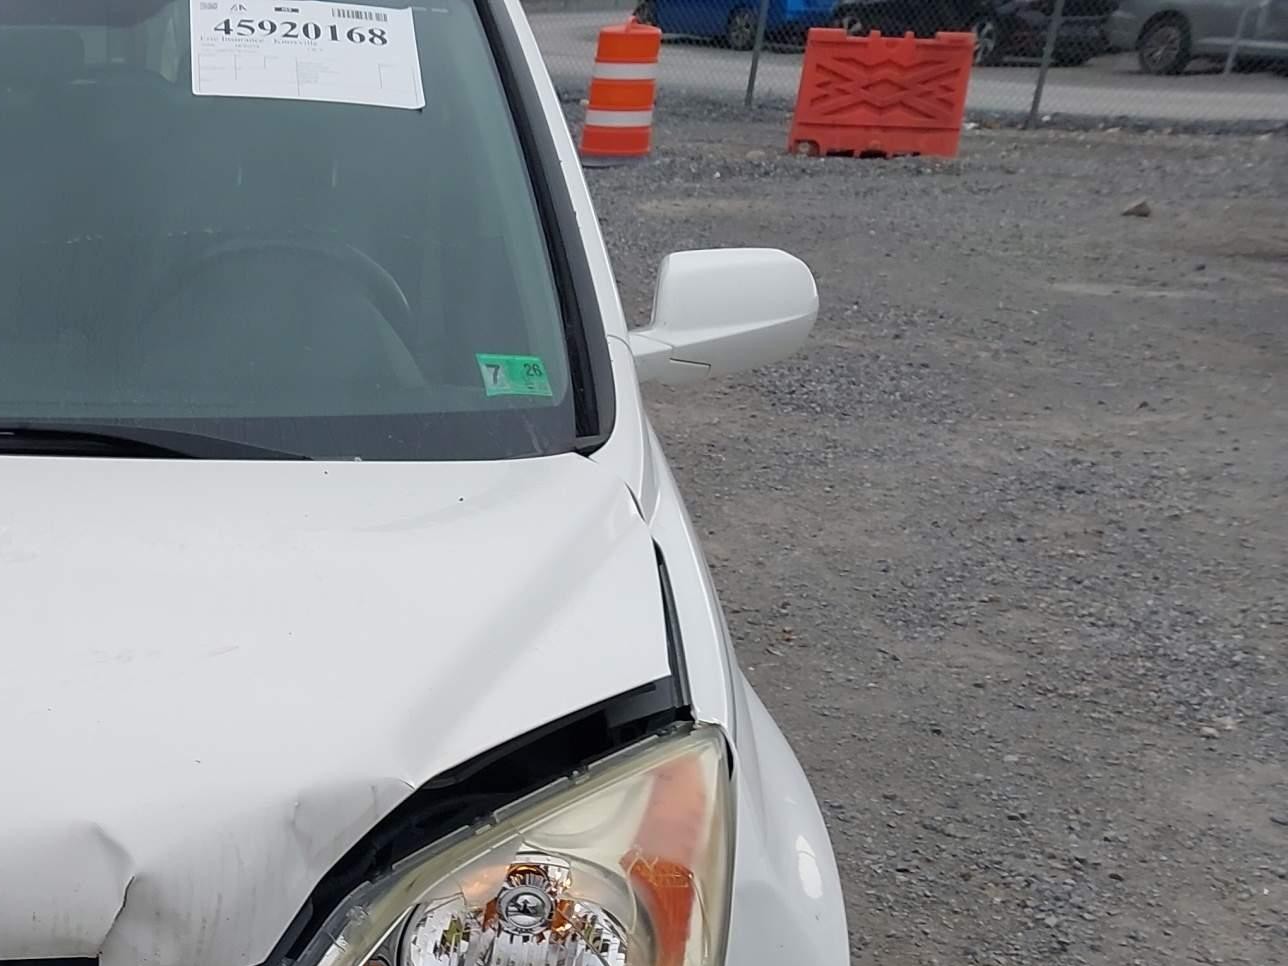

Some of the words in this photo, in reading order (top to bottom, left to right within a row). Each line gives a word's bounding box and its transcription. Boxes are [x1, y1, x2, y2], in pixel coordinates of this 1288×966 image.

[213, 18, 388, 46] 45920168
[485, 363, 500, 384] 7
[523, 363, 542, 377] 26
